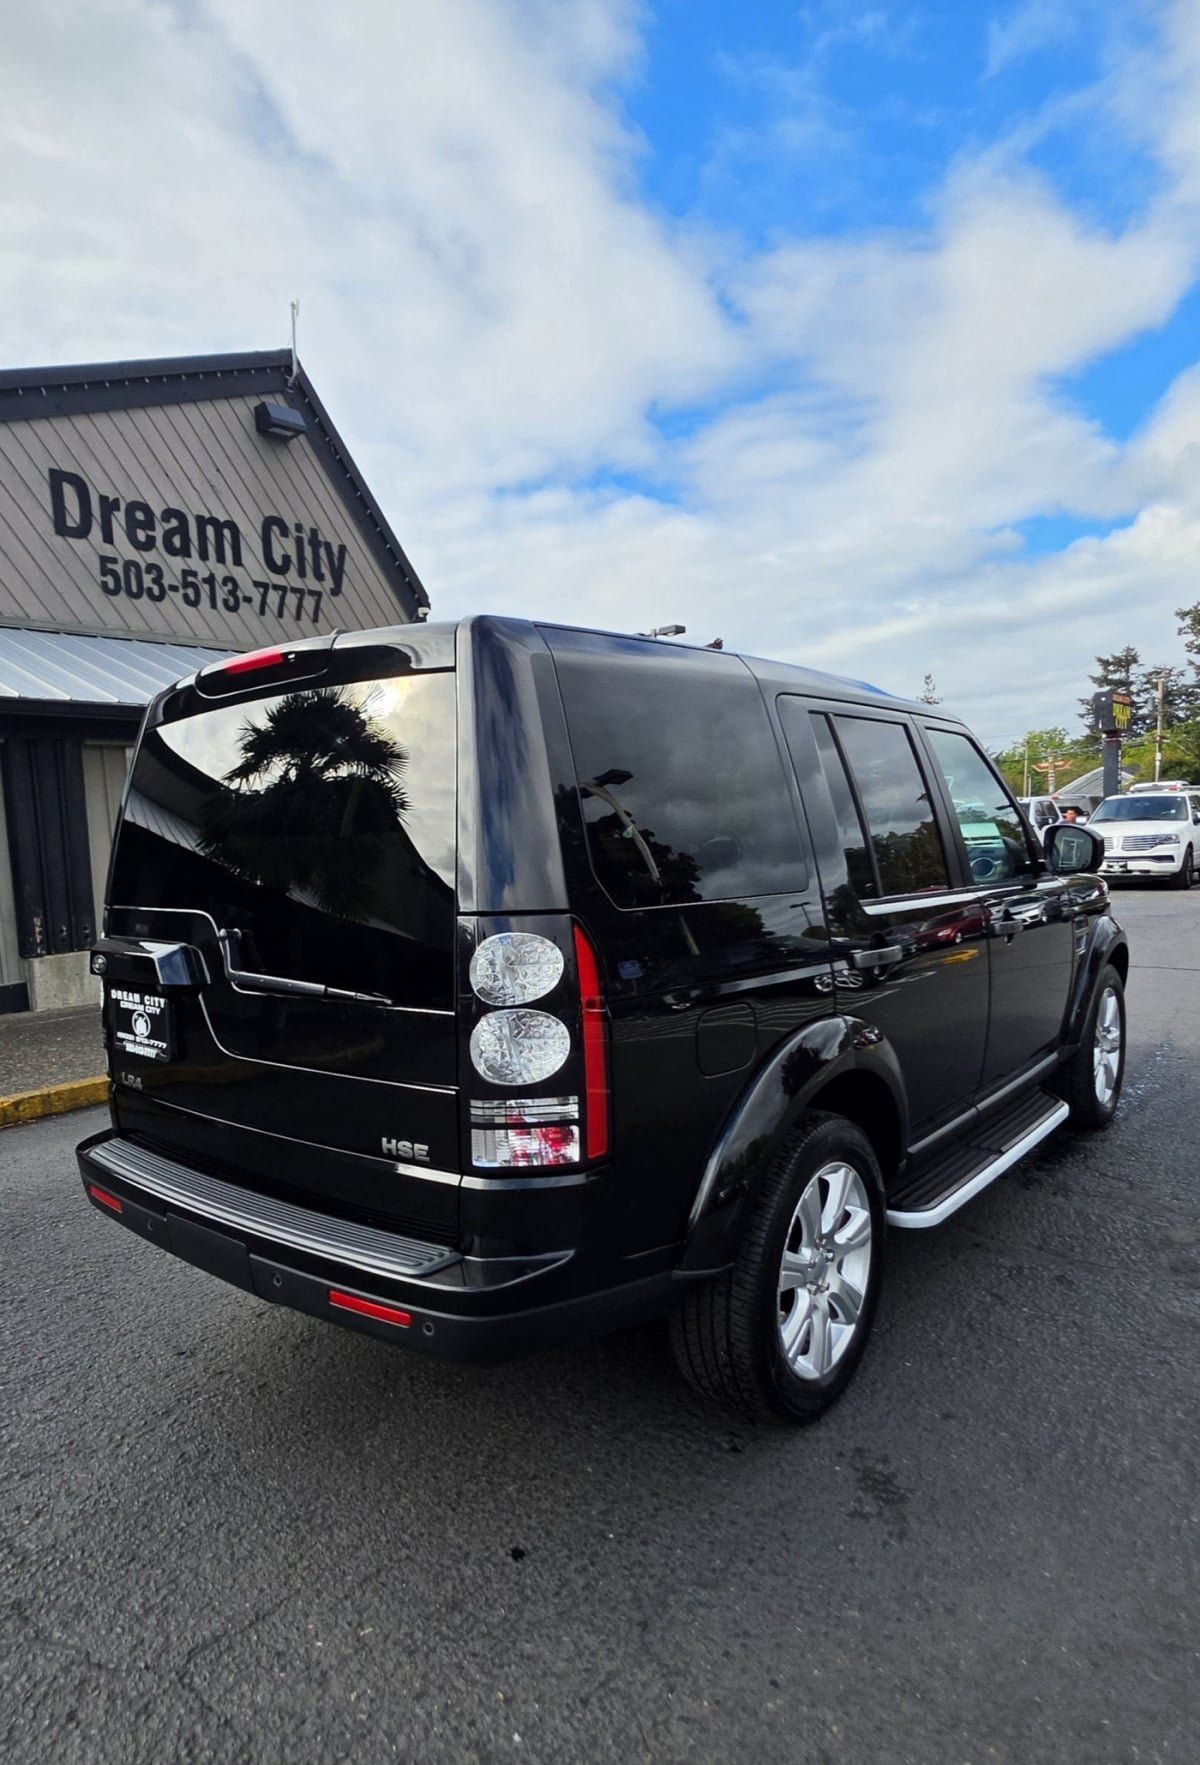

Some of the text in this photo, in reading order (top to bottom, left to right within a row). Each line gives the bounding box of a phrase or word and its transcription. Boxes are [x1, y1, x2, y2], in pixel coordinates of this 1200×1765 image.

[48, 467, 347, 597] Dream City
[99, 554, 323, 624] 503-513-7777
[111, 989, 165, 1008] DREAM CITY
[381, 1136, 431, 1163] HSE
